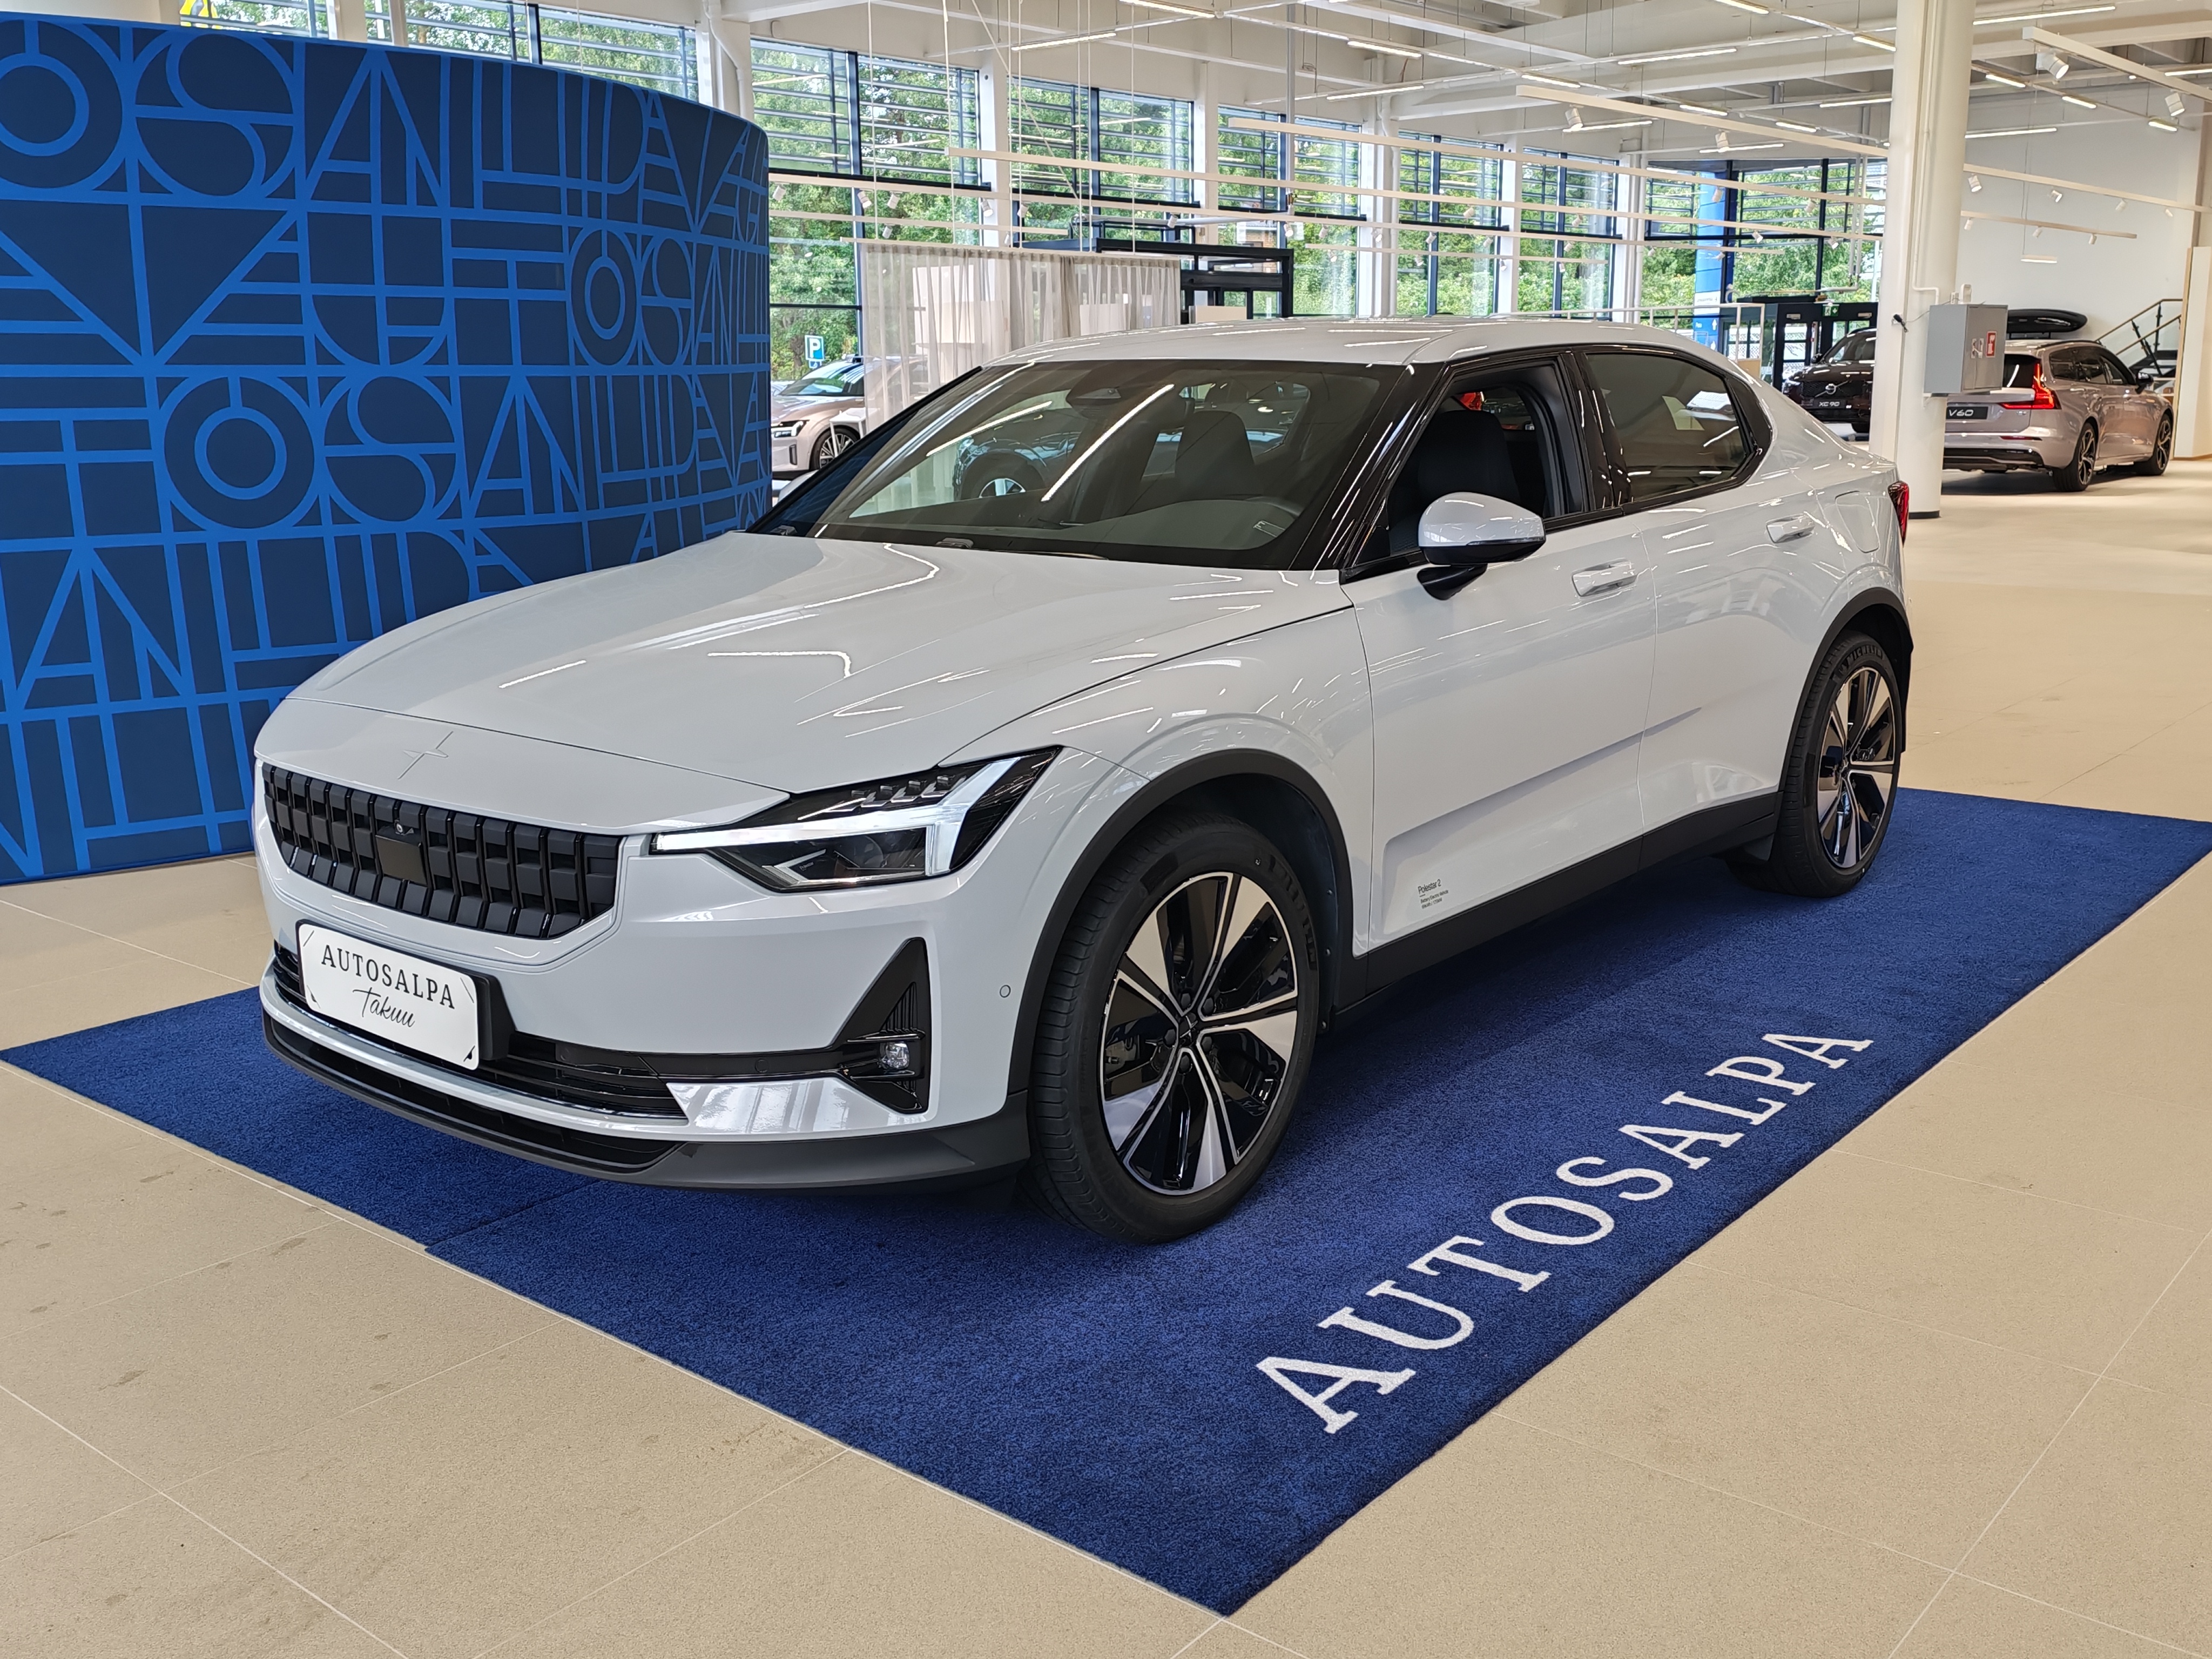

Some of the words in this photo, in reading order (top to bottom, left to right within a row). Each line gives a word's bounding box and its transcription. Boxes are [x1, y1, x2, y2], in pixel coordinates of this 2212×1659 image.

[809, 338, 821, 358] P
[1418, 882, 1437, 894] Polestar
[1437, 878, 1441, 887] 2
[321, 945, 455, 1009] AUTOSALPA
[352, 987, 416, 1028] Takuu
[1256, 1033, 1874, 1434] AUTOSALPA
